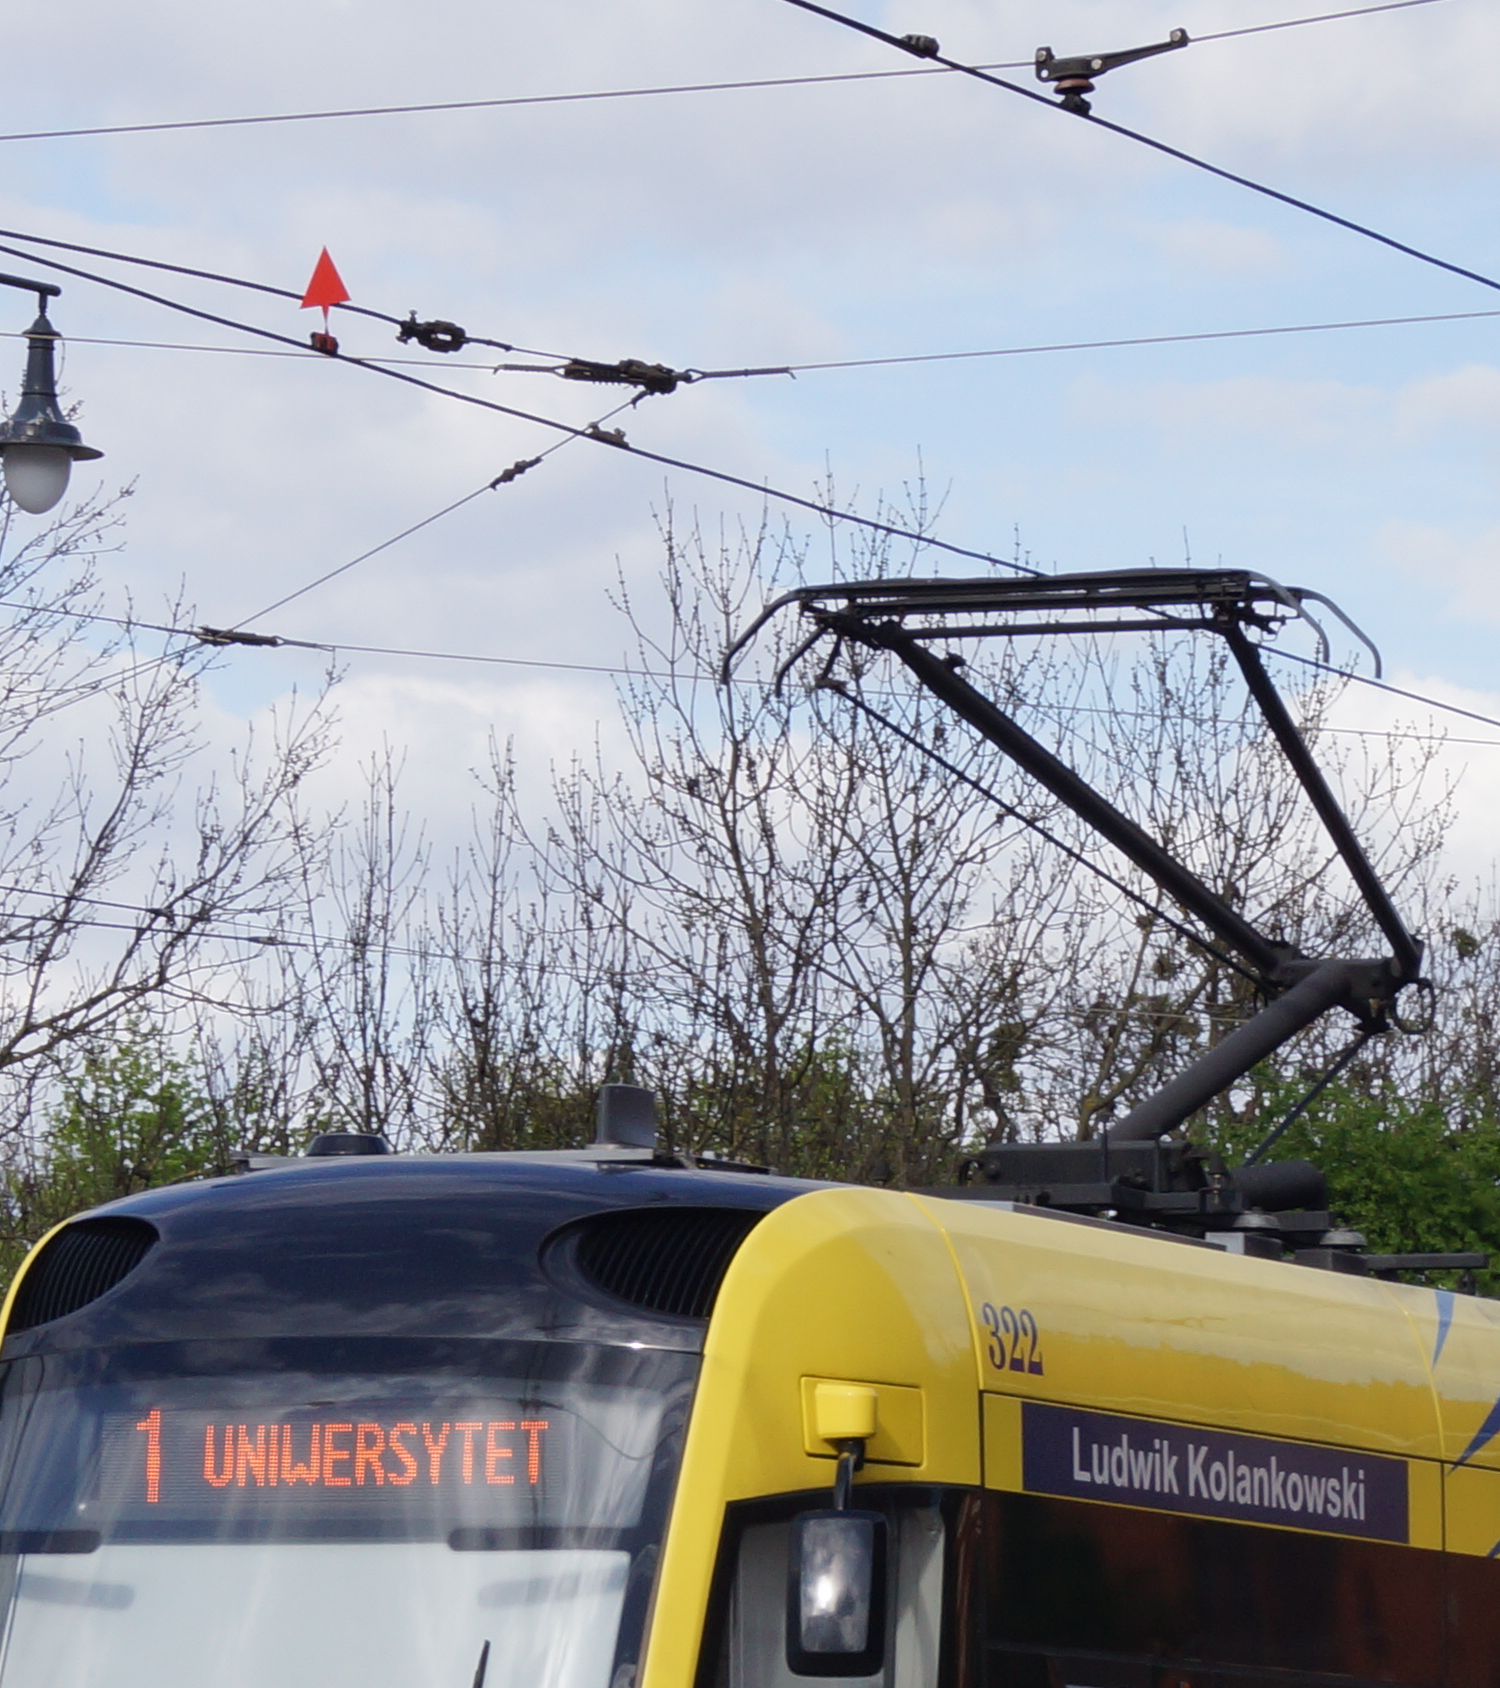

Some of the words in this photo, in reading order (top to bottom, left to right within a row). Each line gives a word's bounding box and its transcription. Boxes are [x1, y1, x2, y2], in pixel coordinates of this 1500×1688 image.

[983, 1302, 1045, 1377] 322
[136, 1410, 161, 1503] 1
[203, 1421, 549, 1487] UNIWERSYTET
[1072, 1426, 1180, 1496] Ludwik
[1188, 1444, 1367, 1521] Kolankowski
